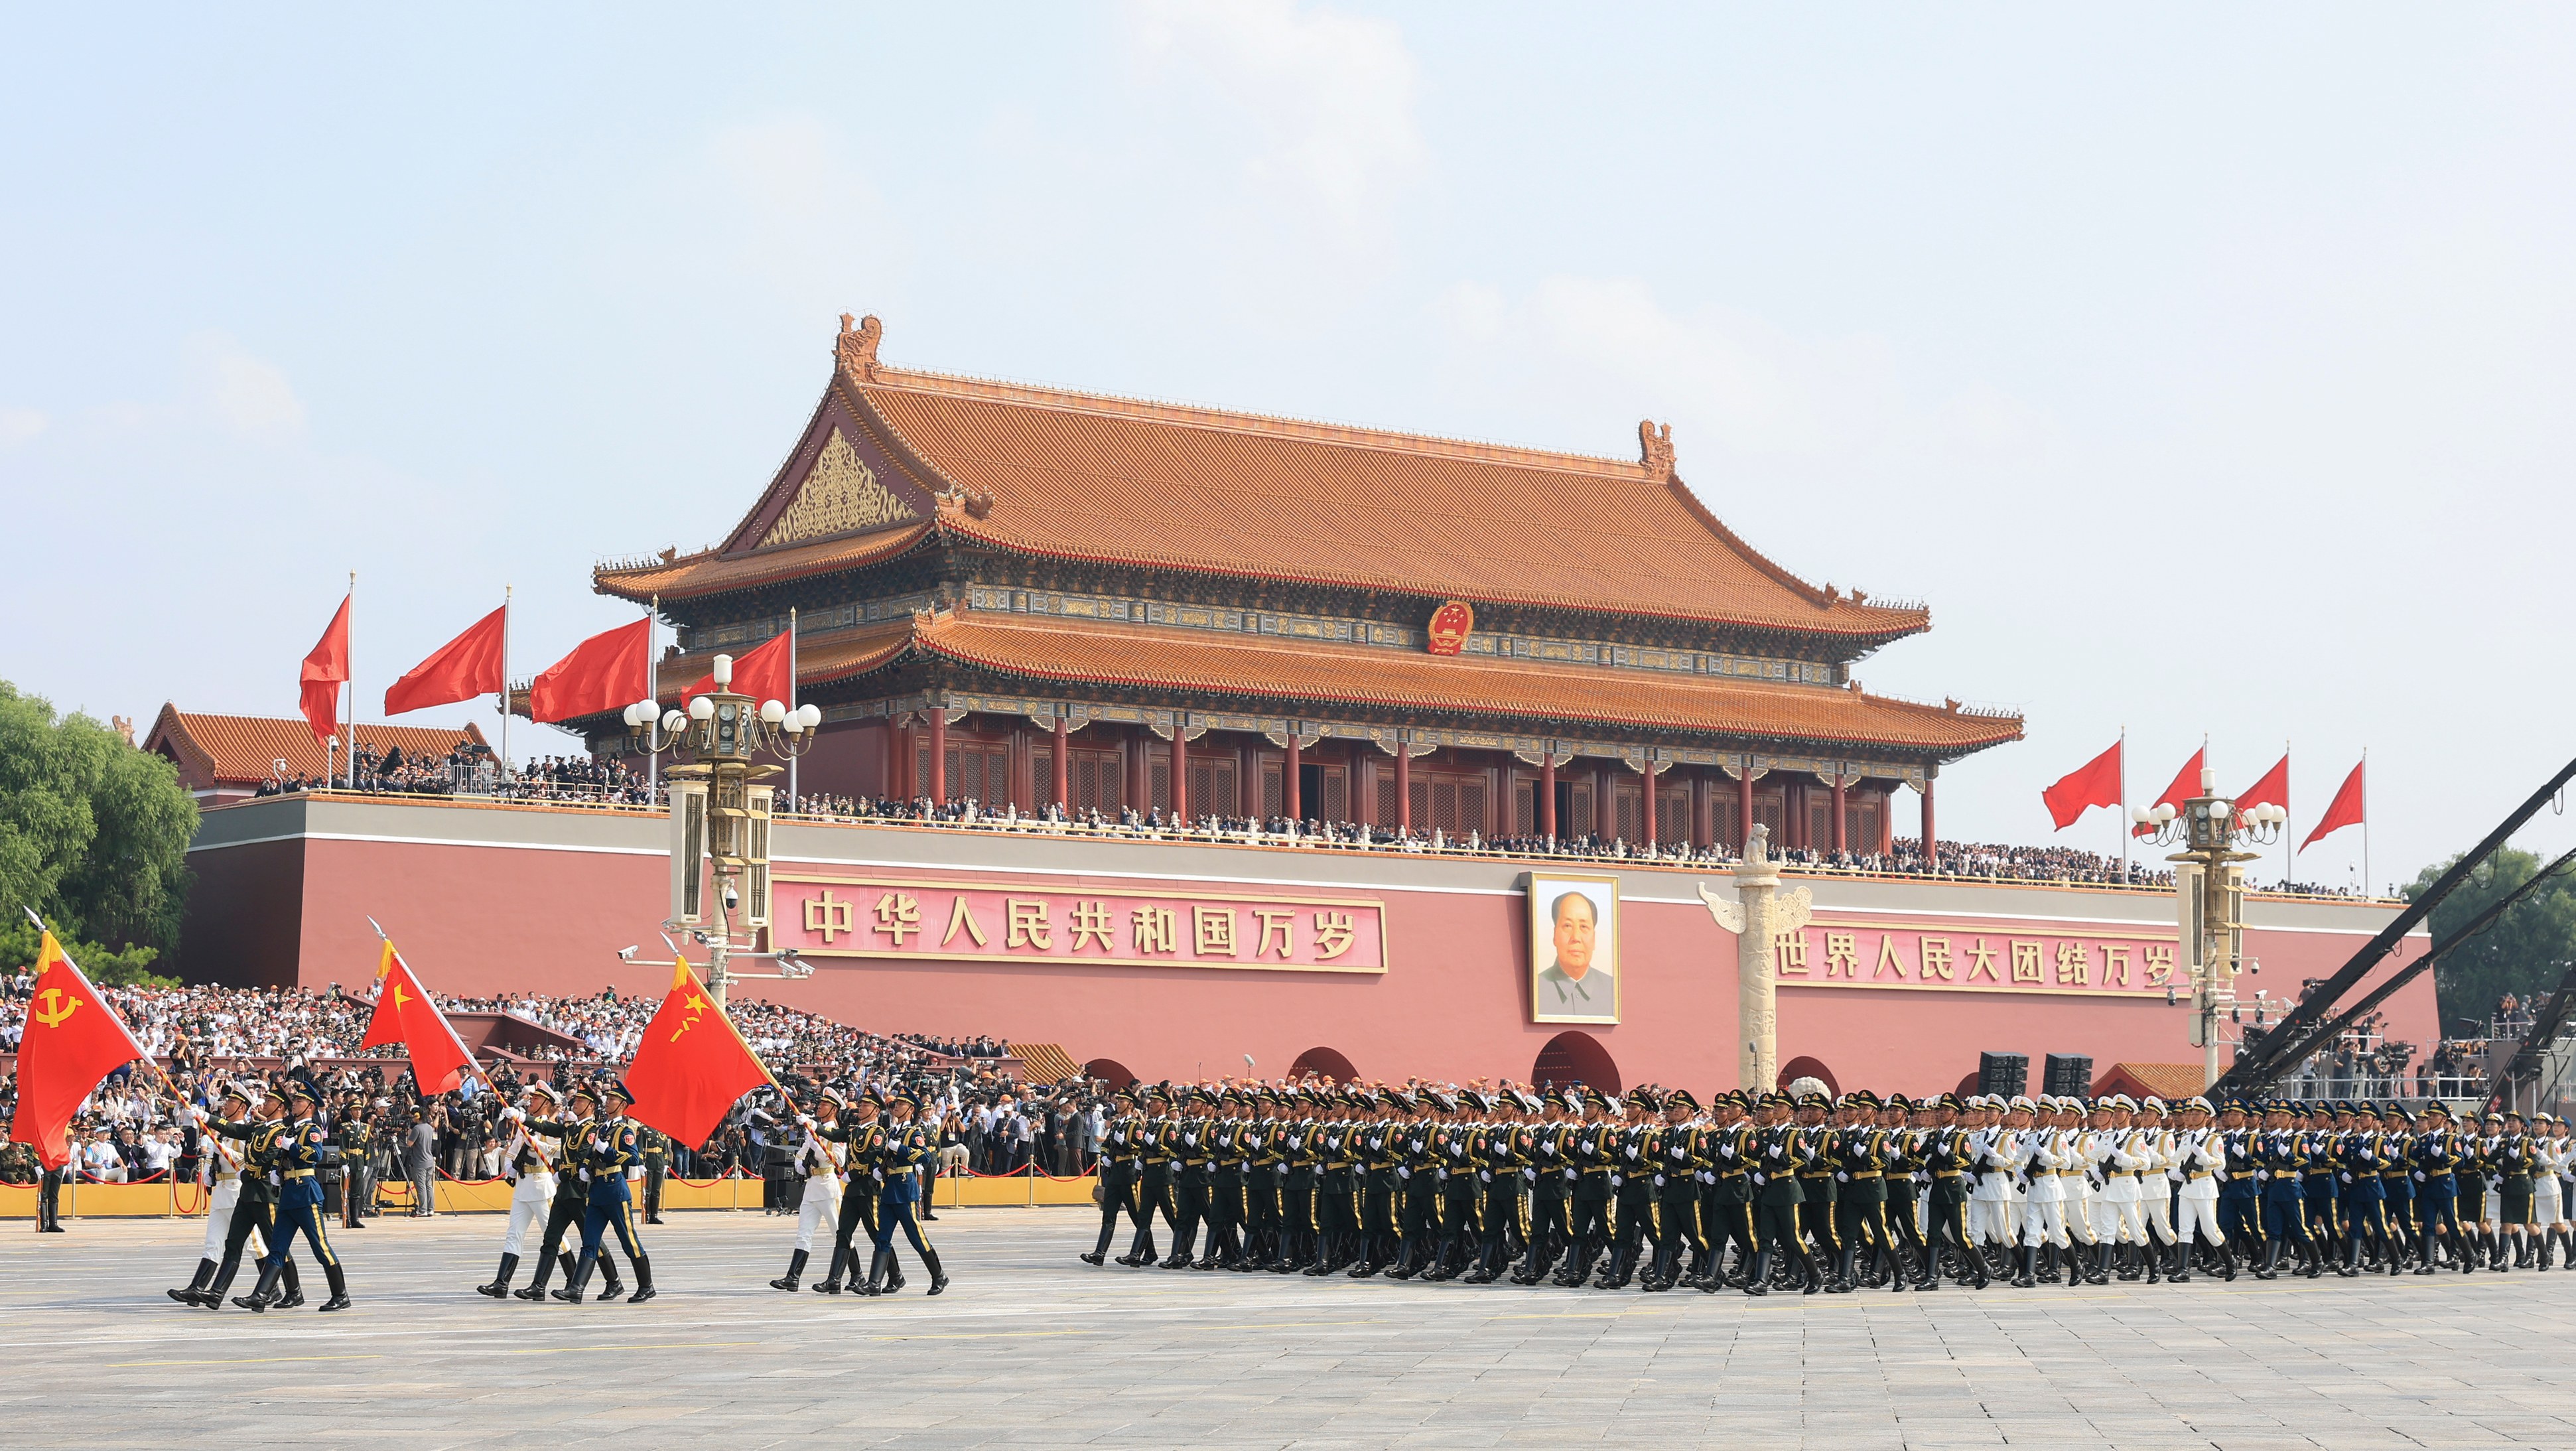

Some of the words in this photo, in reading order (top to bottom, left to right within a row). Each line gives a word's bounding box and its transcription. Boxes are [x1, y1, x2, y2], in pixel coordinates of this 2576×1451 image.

[805, 890, 1355, 959] 中华人民共和国万岁
[1775, 931, 2175, 987] 世界人民大团结万岁
